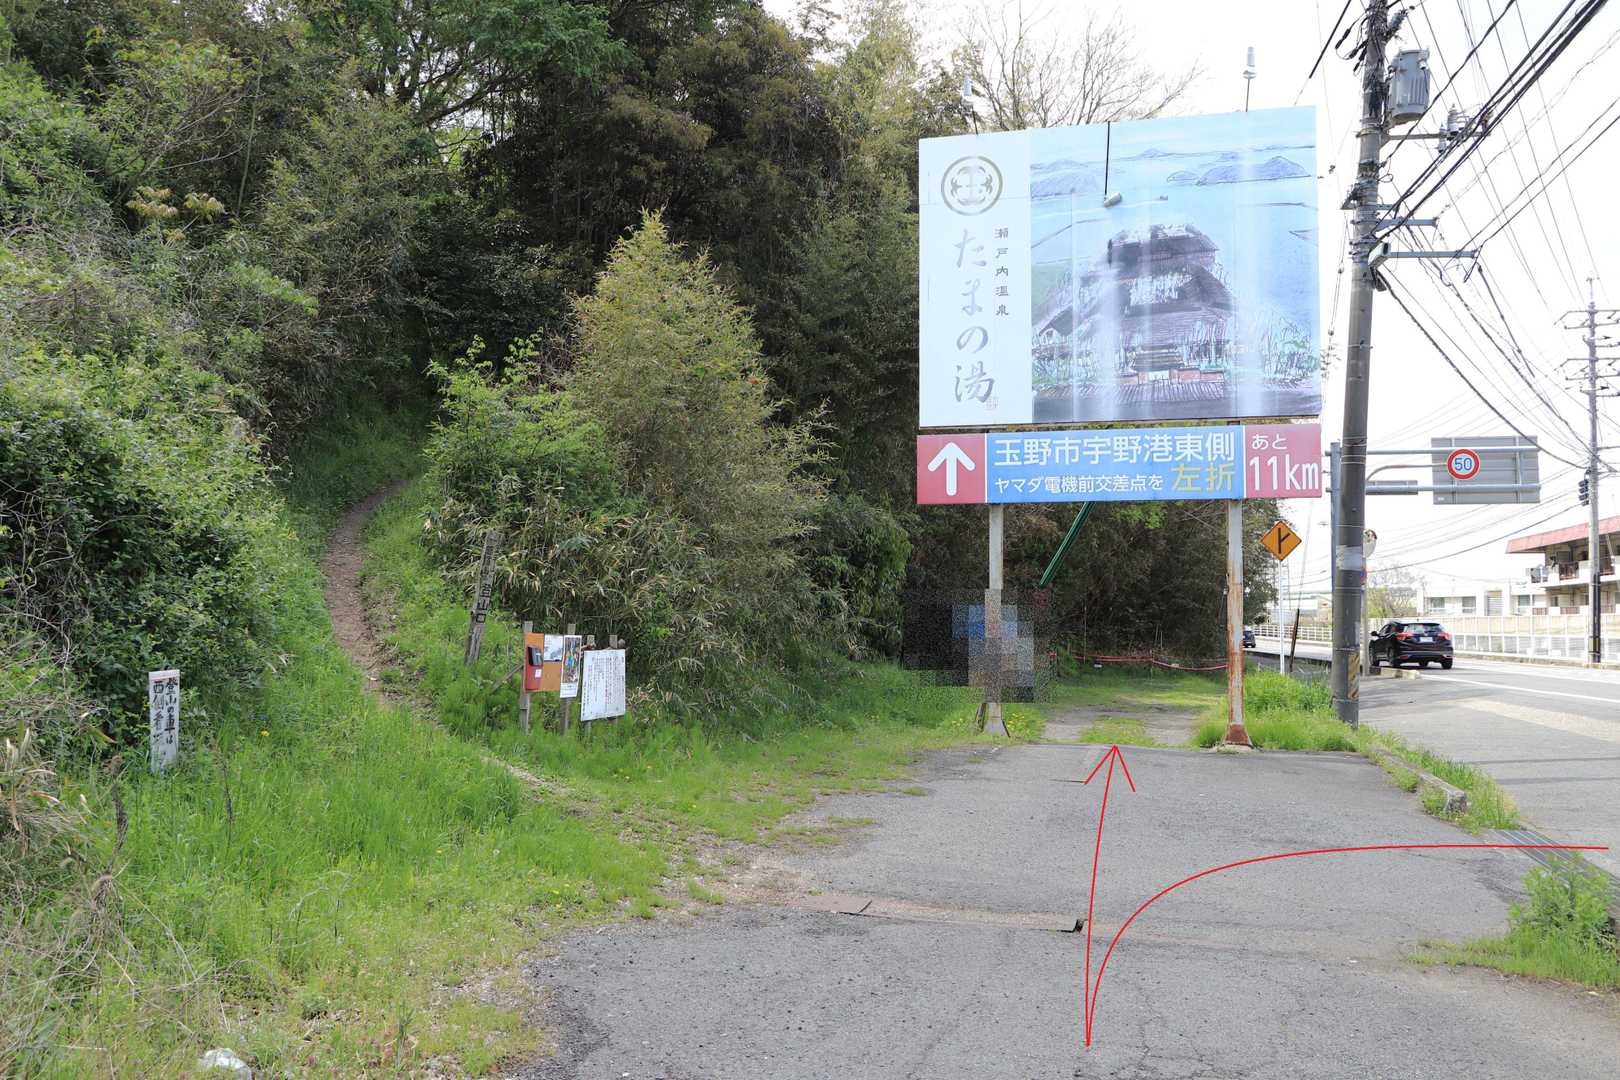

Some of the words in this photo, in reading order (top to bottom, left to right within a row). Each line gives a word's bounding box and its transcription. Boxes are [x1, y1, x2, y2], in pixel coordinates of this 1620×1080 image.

[953, 228, 995, 403] たまの湯
[994, 432, 1235, 466] 玉野市宇野港東側
[1251, 434, 1288, 450] あと
[994, 473, 1164, 494] ヤマダ電機前交差点を
[1170, 462, 1236, 493] 左折
[1249, 454, 1319, 491] 11km
[1454, 457, 1473, 471] 50
